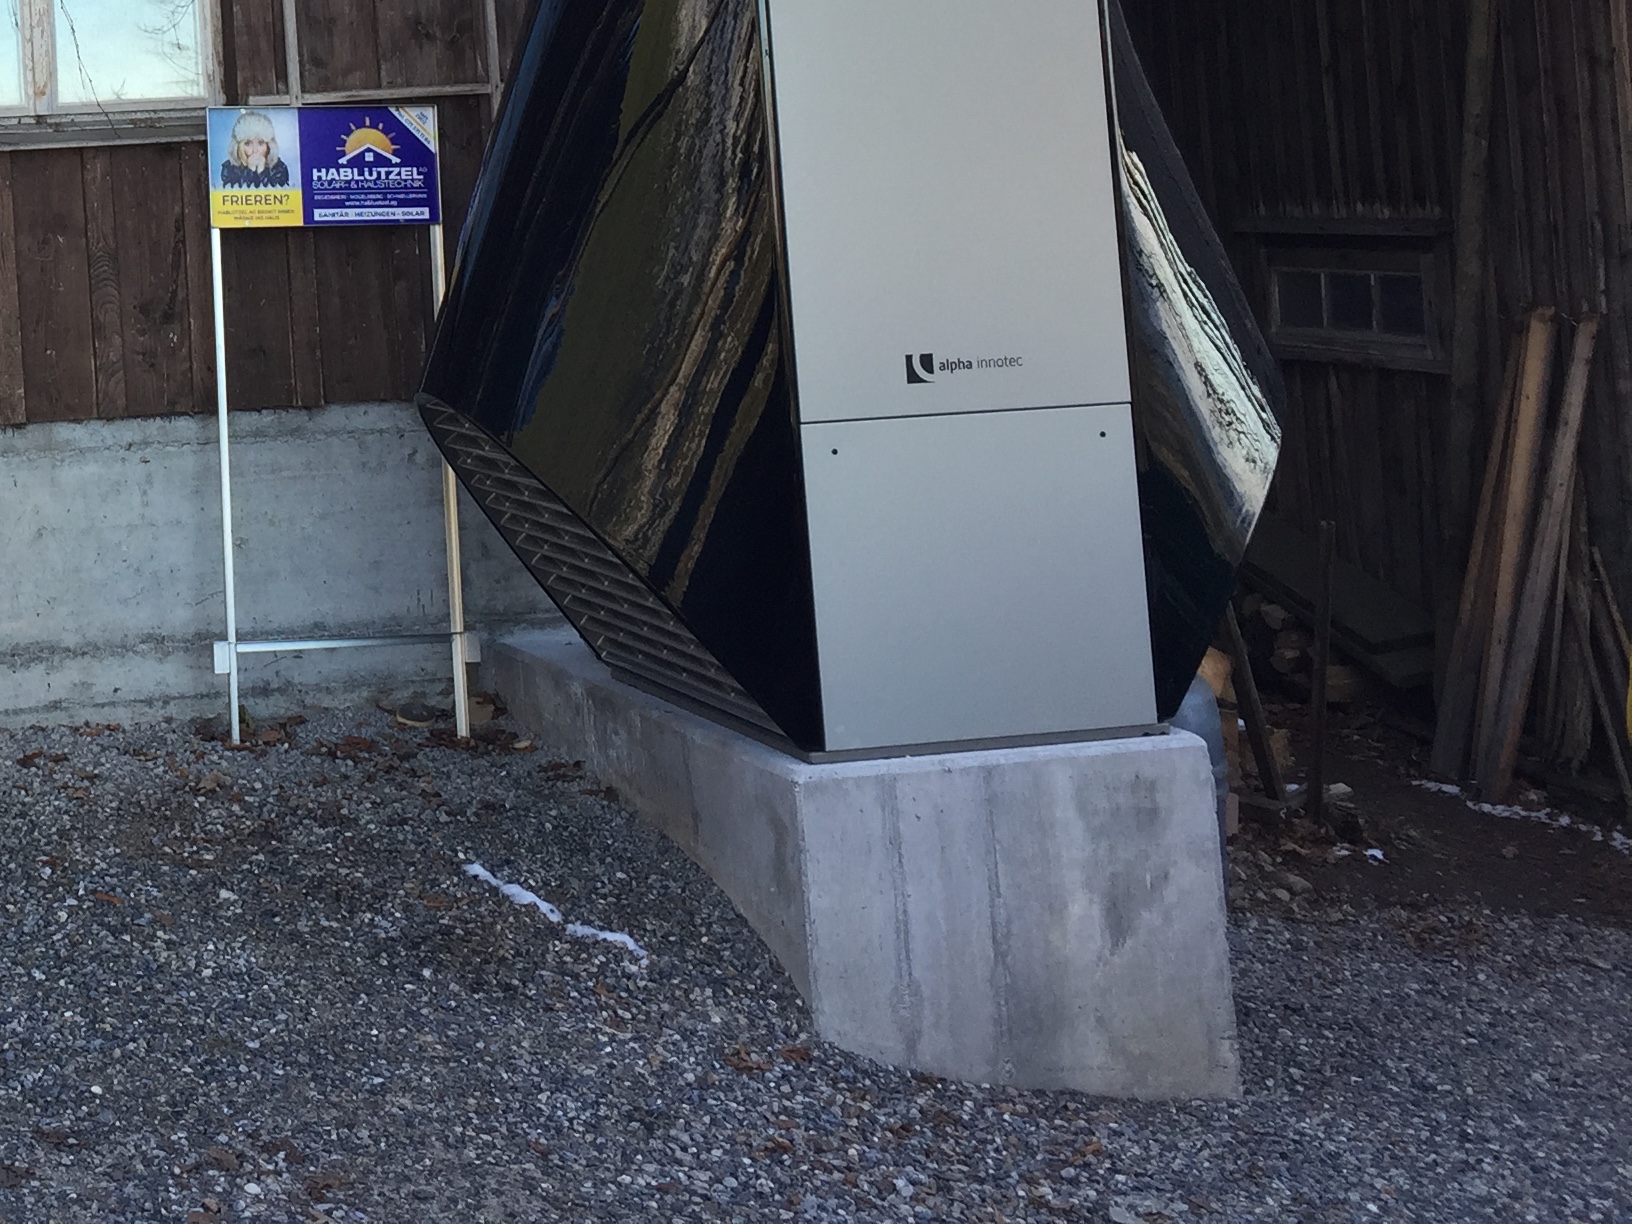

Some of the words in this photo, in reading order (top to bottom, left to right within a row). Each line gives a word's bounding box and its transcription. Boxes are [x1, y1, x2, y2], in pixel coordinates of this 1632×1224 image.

[312, 167, 424, 180] HABLÜTZEL
[350, 180, 358, 188] &
[359, 179, 425, 189] HAUSTECHNIK
[222, 194, 290, 206] FRIEREN?
[938, 358, 973, 374] alpha
[976, 356, 1024, 369] innotec
